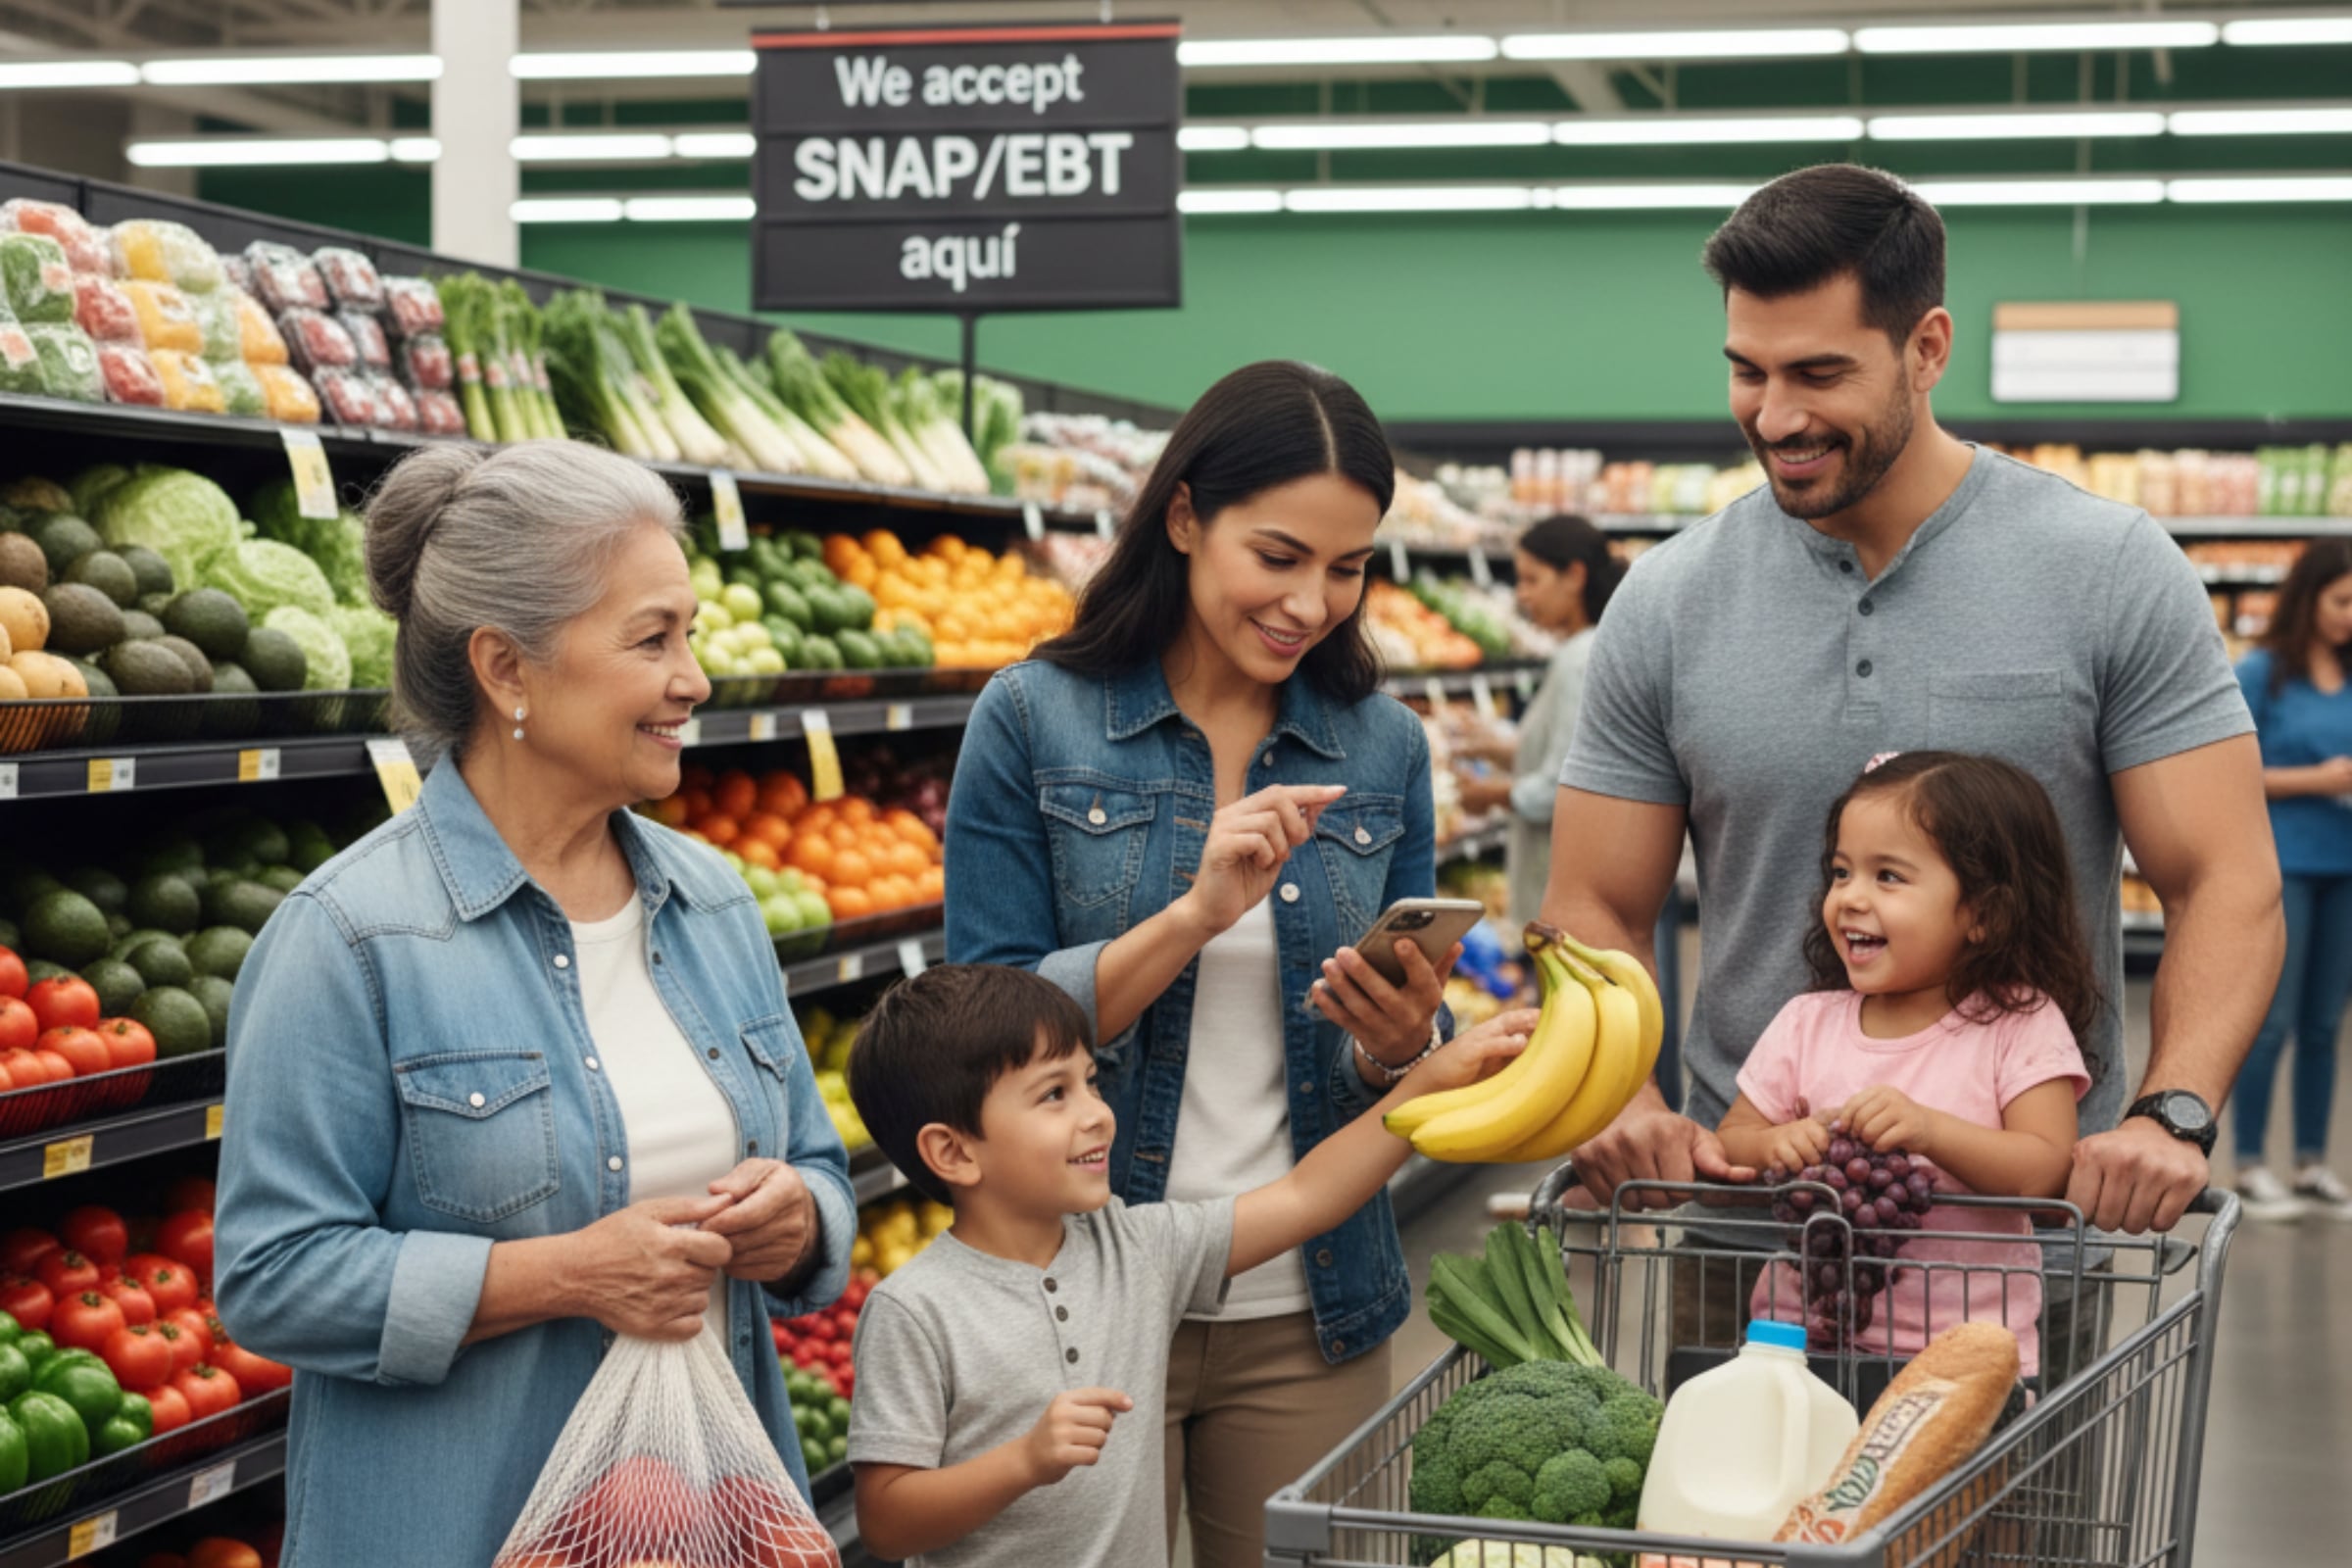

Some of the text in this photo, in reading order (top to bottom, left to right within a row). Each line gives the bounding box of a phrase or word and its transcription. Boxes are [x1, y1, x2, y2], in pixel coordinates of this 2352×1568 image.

[834, 54, 1085, 115] We accept
[794, 132, 1134, 201] SNAP/EBT
[900, 222, 1021, 293] aquí
